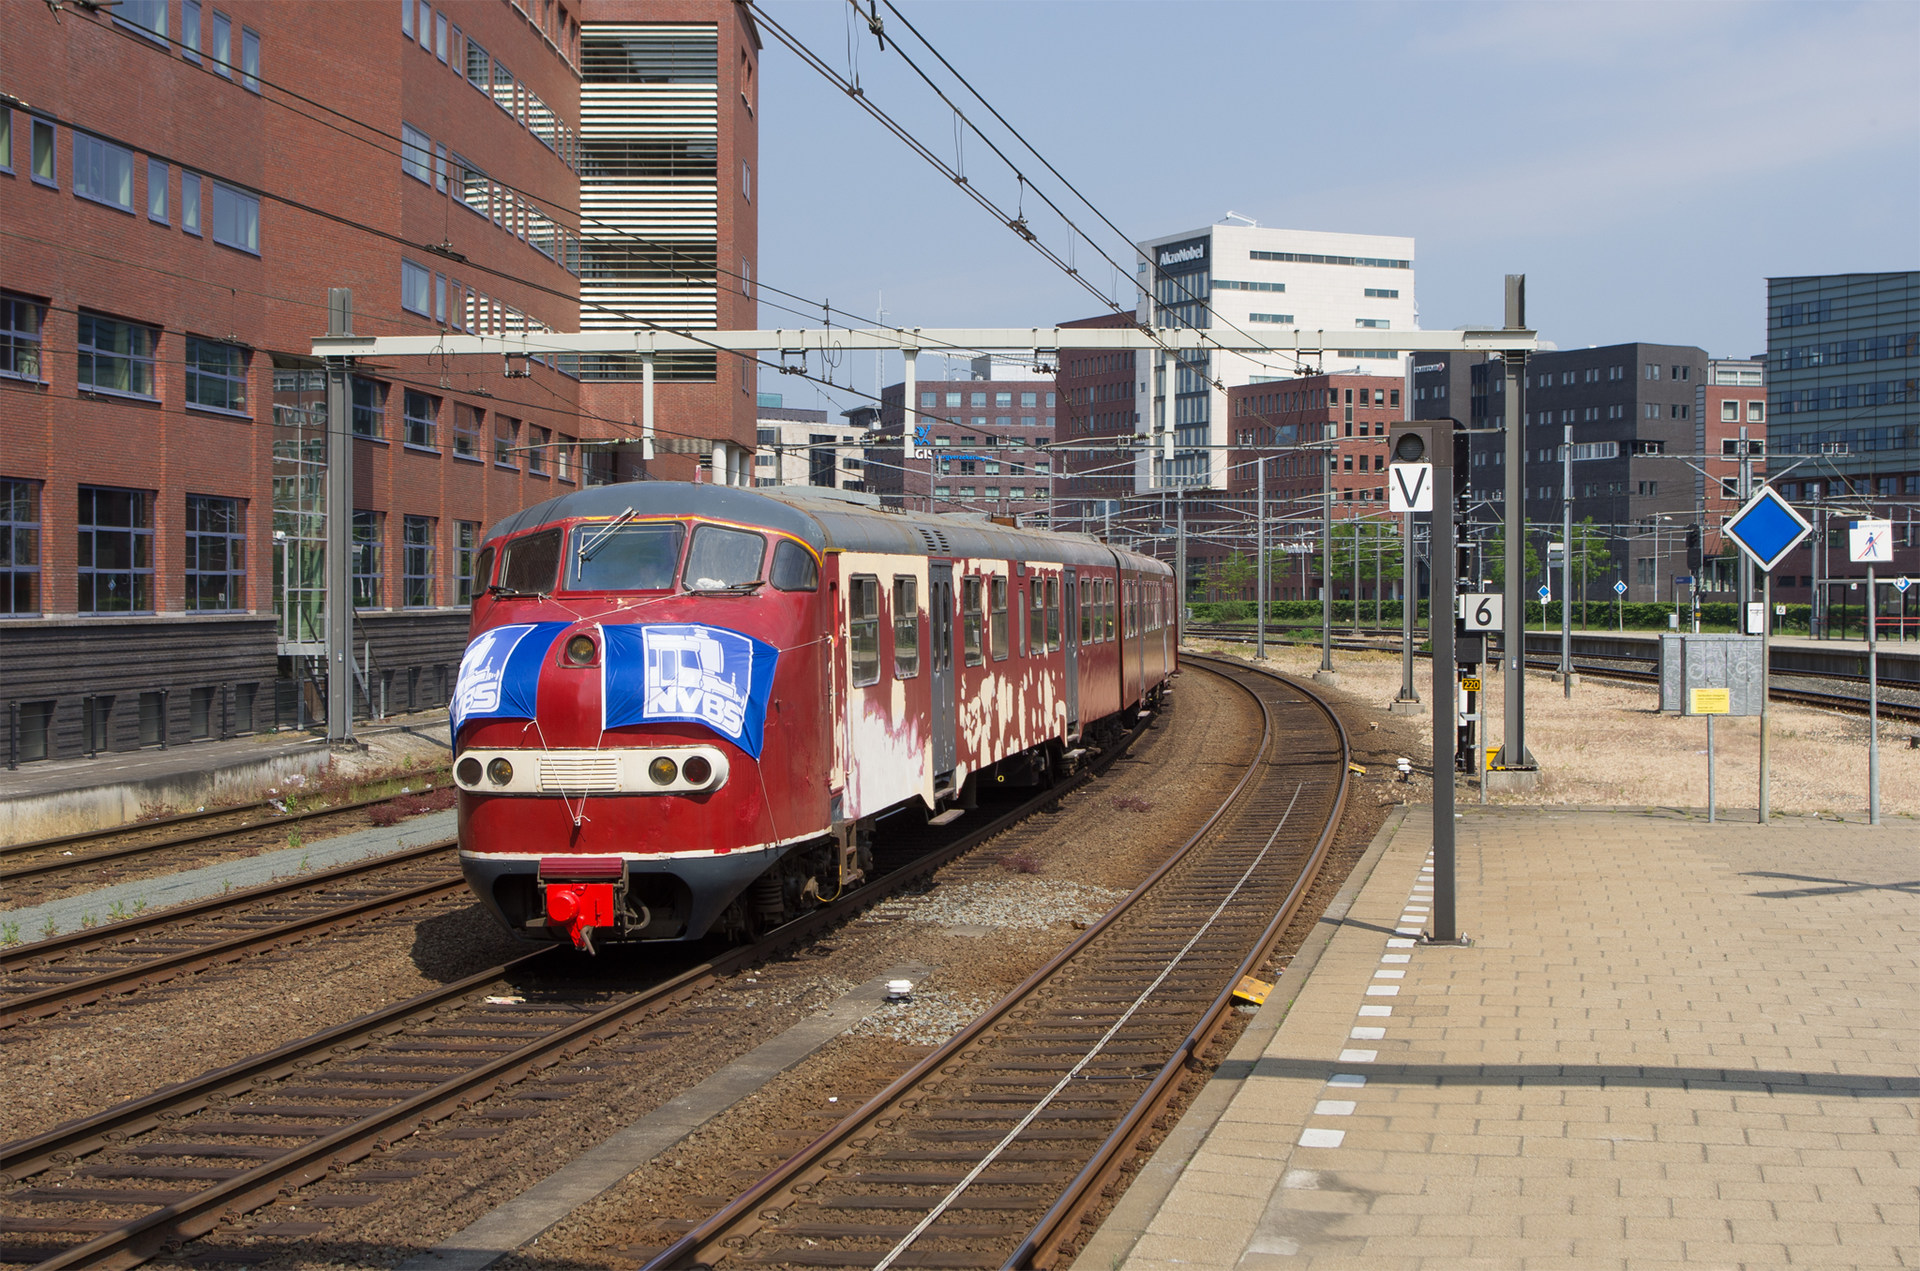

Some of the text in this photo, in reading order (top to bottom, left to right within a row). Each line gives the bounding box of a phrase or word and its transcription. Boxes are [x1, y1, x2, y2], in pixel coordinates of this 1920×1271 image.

[1160, 244, 1204, 266] AkzoNobel
[913, 449, 933, 459] GIS
[1394, 467, 1428, 508] V
[1475, 597, 1492, 626] 6
[1463, 680, 1479, 689] 220
[649, 687, 742, 733] NVBS
